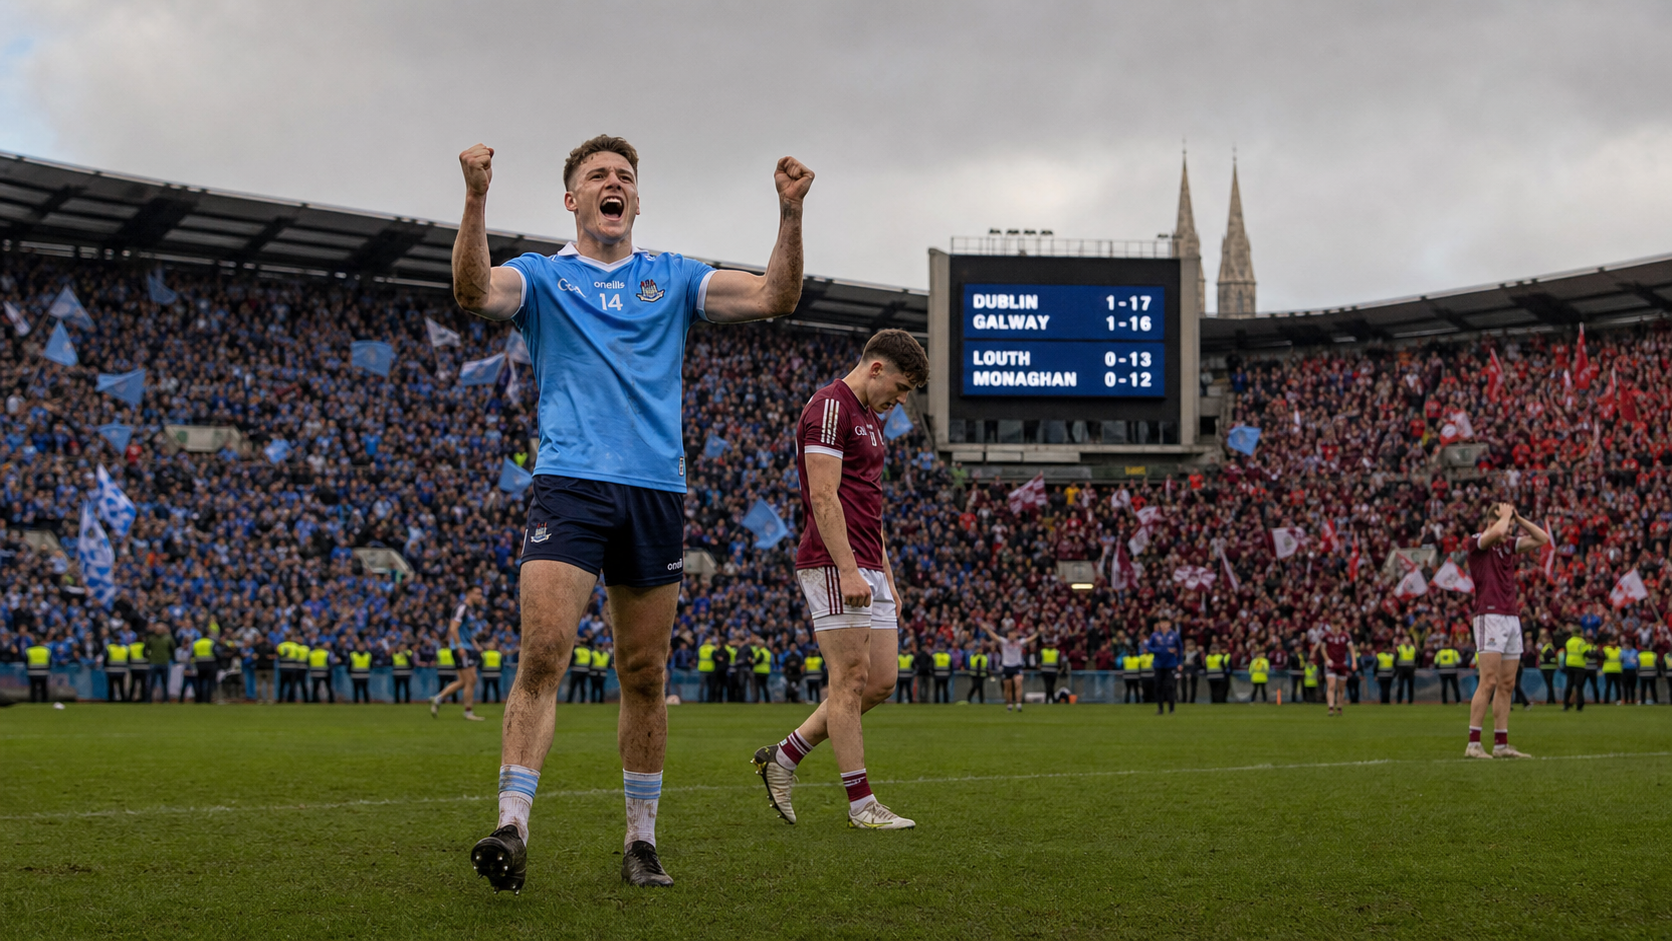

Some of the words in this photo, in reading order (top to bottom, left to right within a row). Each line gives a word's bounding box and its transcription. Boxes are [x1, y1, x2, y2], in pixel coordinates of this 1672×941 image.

[599, 293, 623, 311] 14
[973, 294, 1038, 309] DUBLIN
[1106, 295, 1152, 311] 1-17
[973, 315, 1050, 330] GALWAY
[1106, 315, 1152, 331] 1-16
[973, 350, 1030, 366] LOUTH
[1105, 351, 1152, 367] 0-13
[973, 371, 1077, 387] MONAGHAN
[1105, 372, 1152, 388] 0-12
